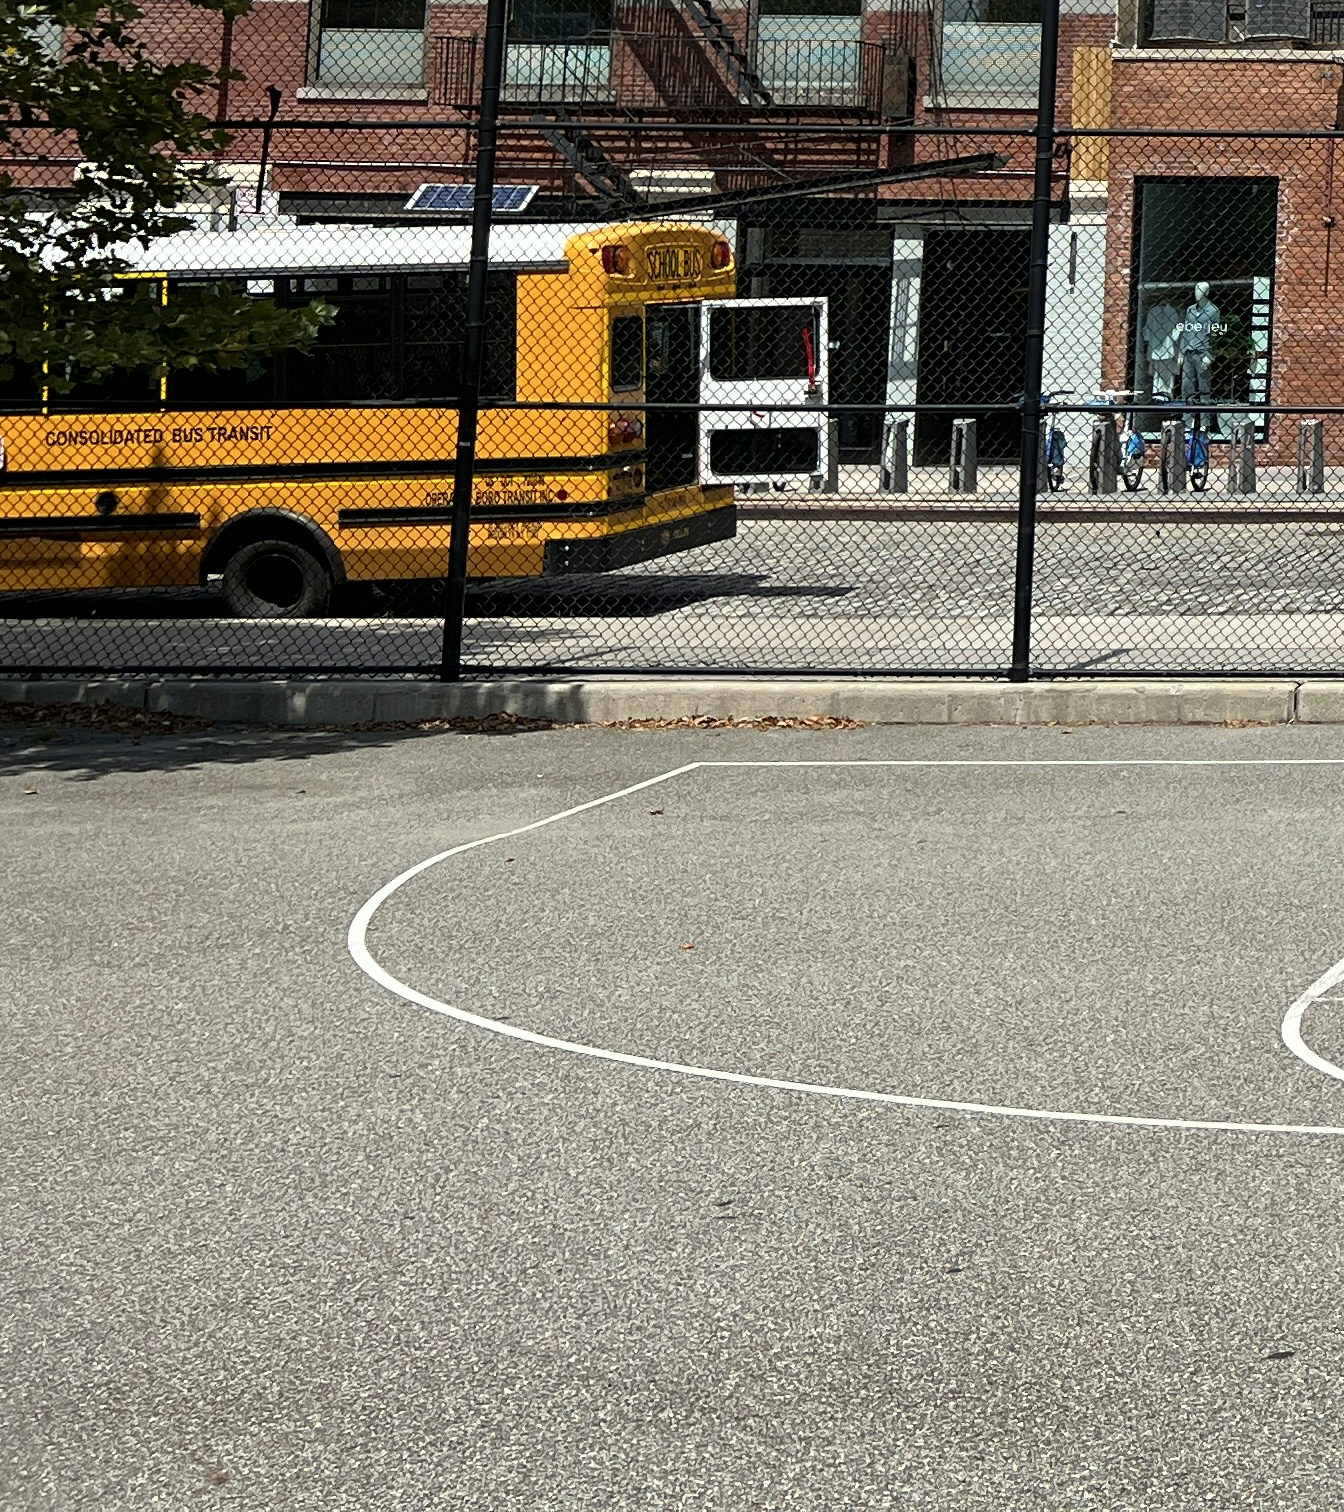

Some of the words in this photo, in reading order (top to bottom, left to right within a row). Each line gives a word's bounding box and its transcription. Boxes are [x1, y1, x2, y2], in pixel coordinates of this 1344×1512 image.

[647, 249, 681, 279] SCHOOL
[683, 248, 702, 277] BUS
[45, 428, 163, 446] CONSOLIDATED
[172, 427, 203, 443] BUS
[206, 425, 272, 441] TRANSIT
